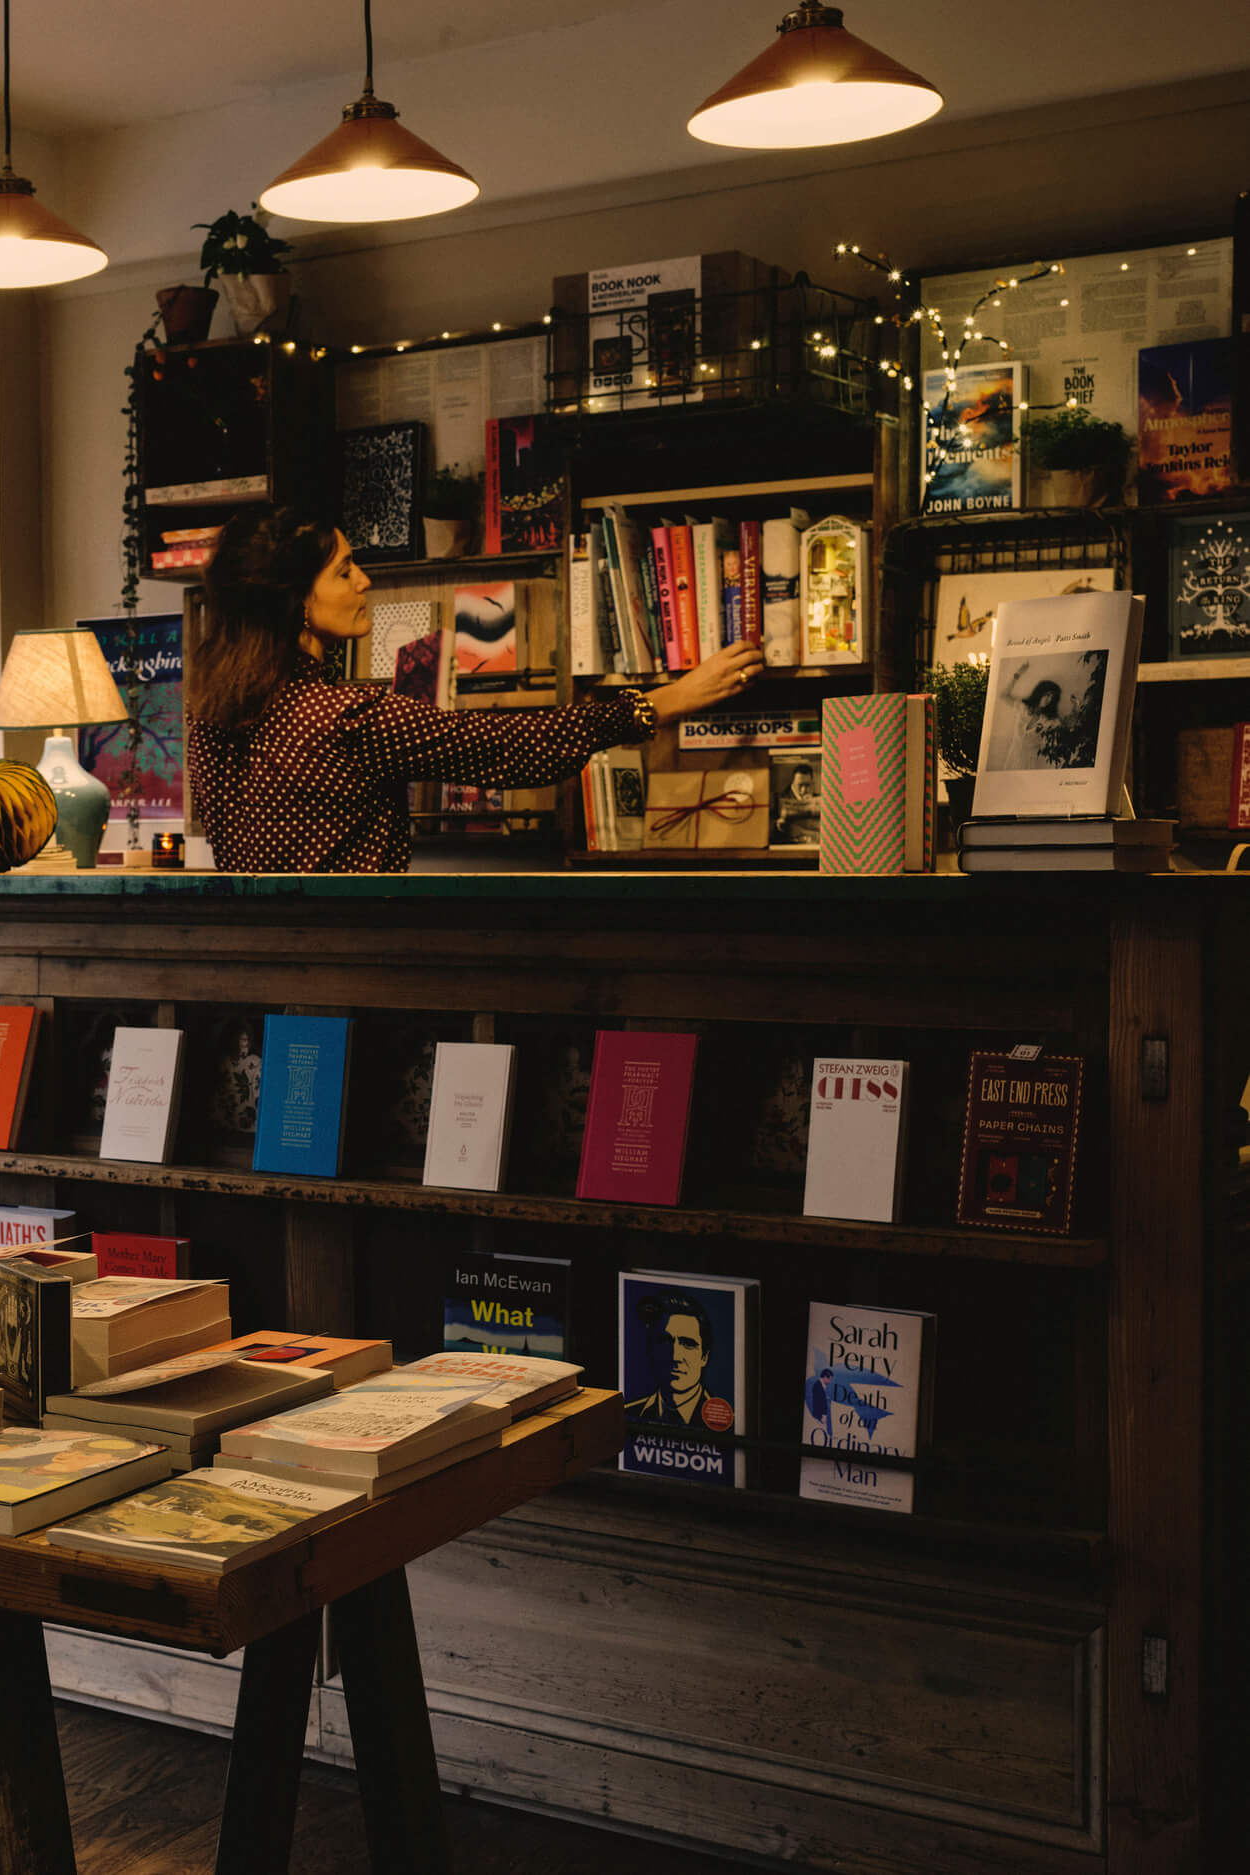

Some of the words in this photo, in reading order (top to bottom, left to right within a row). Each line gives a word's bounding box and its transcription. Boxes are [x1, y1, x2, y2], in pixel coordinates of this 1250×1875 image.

[592, 279, 624, 293] BOOK
[627, 274, 661, 288] NOOK
[1072, 367, 1087, 376] THE
[1063, 375, 1095, 391] BOOK
[1063, 389, 1095, 405] THIEF
[1144, 412, 1230, 433] Atmospher
[1168, 442, 1213, 458] Taylor
[927, 497, 962, 513] JOHN
[966, 495, 1010, 510] BOYNE
[1199, 575, 1240, 586] RETURN
[743, 556, 757, 633] VERMEER
[1213, 594, 1241, 605] KING
[1054, 634, 1071, 642] Patti
[1072, 632, 1091, 641] Smith
[685, 720, 793, 736] BOOKSHOPS
[109, 798, 147, 807] ARPER
[151, 798, 173, 807] LEE
[818, 1063, 854, 1074] STEFAN
[855, 1064, 890, 1076] ZWEIG
[981, 1078, 1006, 1104] EAST
[1008, 1080, 1032, 1105] END
[1033, 1081, 1069, 1107] PRESS
[979, 1119, 1014, 1132] PAPER
[1016, 1122, 1065, 1135] CHAINS
[615, 1148, 649, 1156] WILLIAM
[107, 1248, 140, 1261] Mother
[142, 1250, 169, 1264] Mary
[455, 1269, 479, 1286] Ian
[484, 1272, 551, 1293] McEwan
[471, 1299, 534, 1328] What
[829, 1315, 898, 1350] Sarah
[830, 1342, 898, 1378] Perry
[833, 1383, 887, 1409] Death
[839, 1410, 855, 1429] of
[857, 1417, 878, 1429] an
[635, 1433, 721, 1456] ARTIFICIAL
[811, 1427, 906, 1457] Ordinary
[634, 1445, 723, 1475] WISDOM
[833, 1461, 877, 1487] Man
